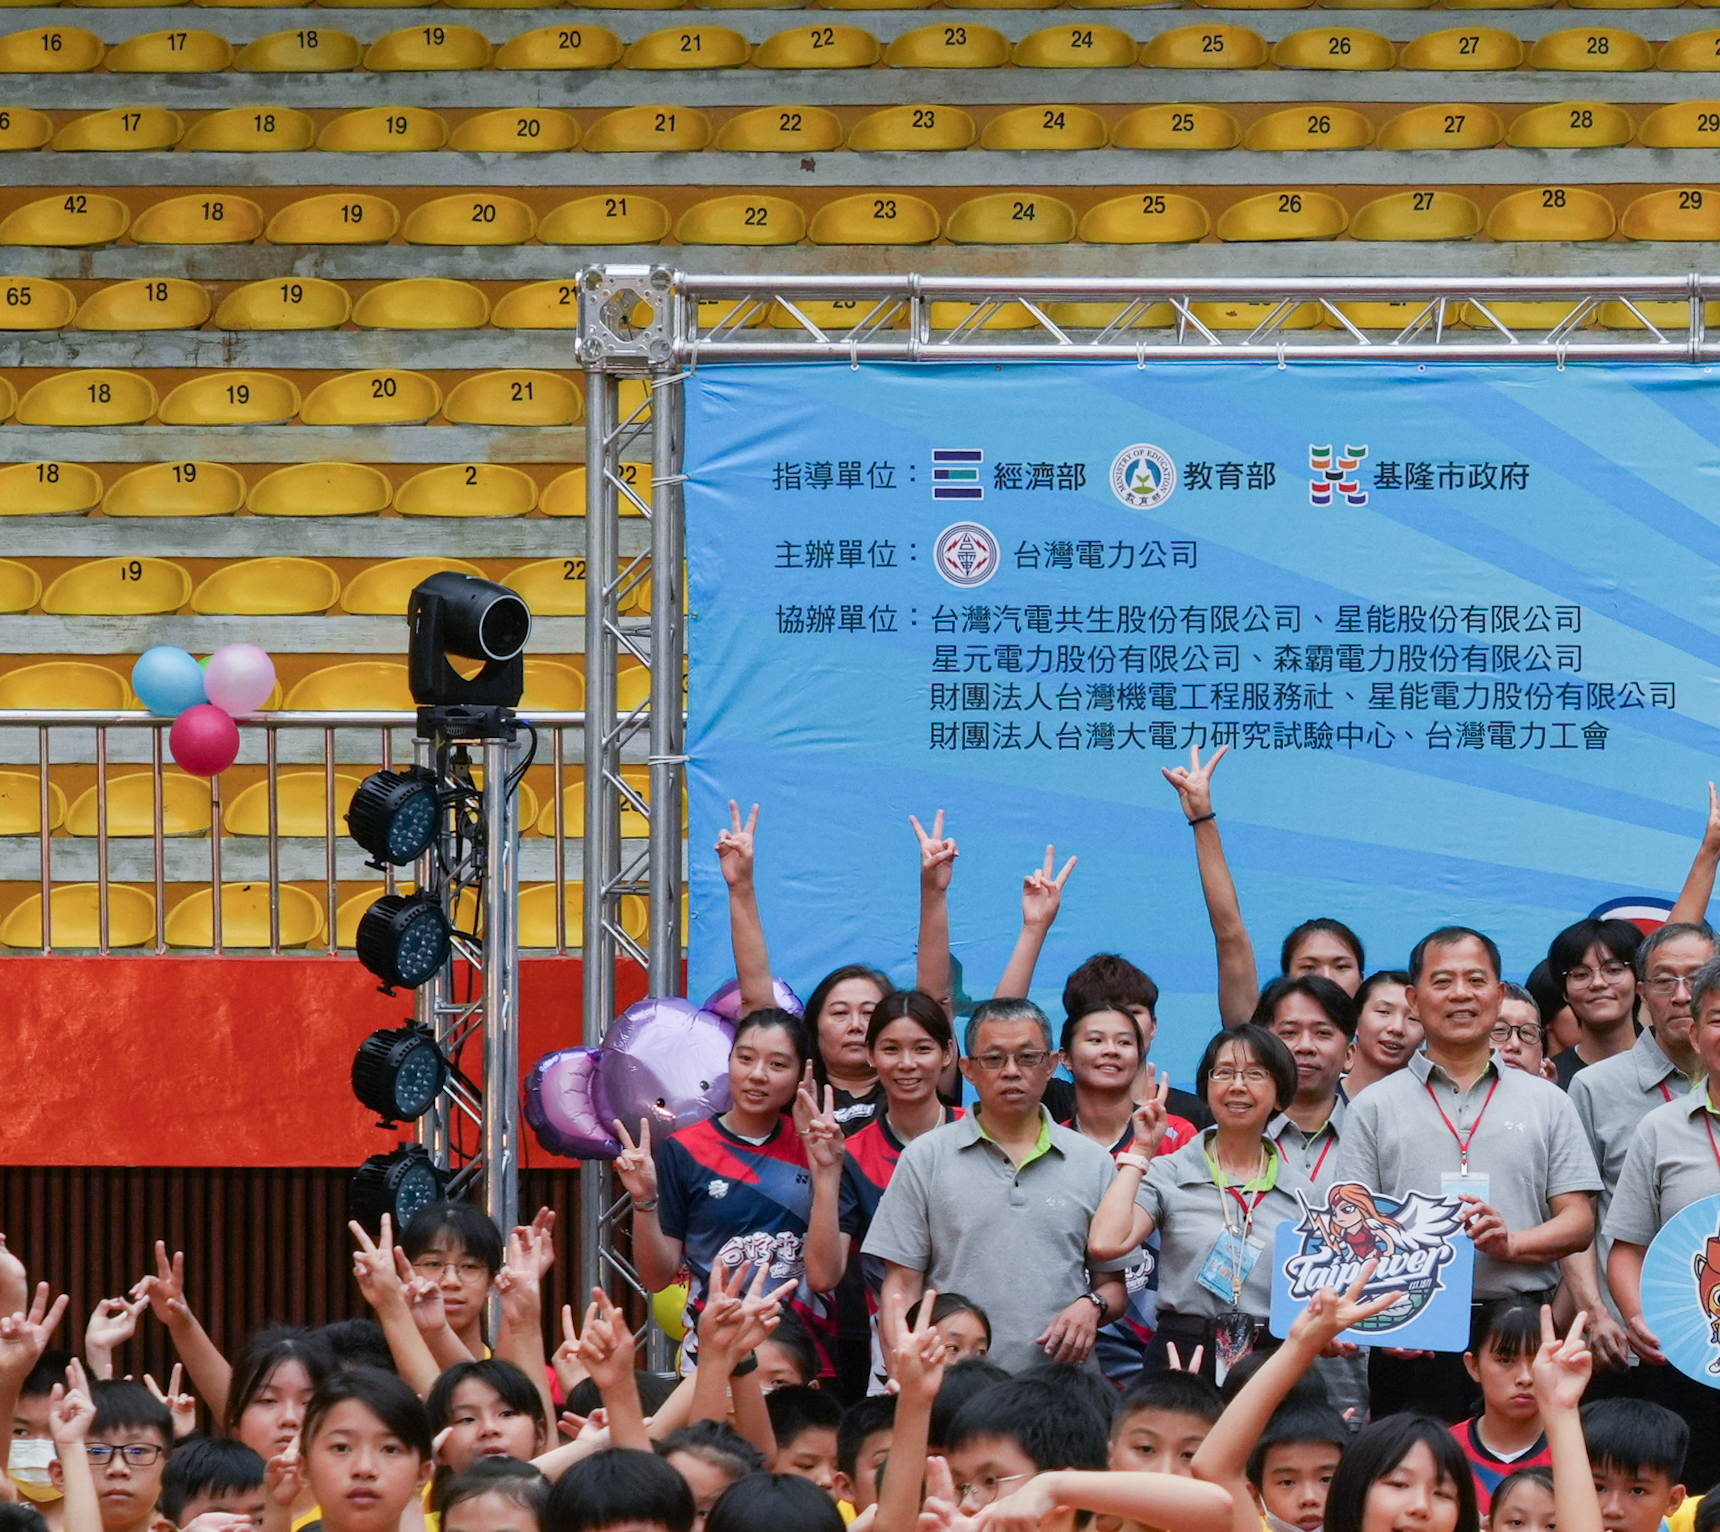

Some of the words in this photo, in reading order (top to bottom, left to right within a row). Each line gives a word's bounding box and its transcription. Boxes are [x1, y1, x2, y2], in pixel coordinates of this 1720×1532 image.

[40, 32, 63, 53] 16
[295, 29, 319, 50] 18
[557, 29, 582, 50] 20
[679, 33, 701, 53] 21
[943, 26, 967, 47] 23
[1458, 35, 1480, 56] 27
[120, 112, 142, 133] 17
[385, 115, 408, 136] 19
[654, 112, 676, 133] 21
[911, 108, 935, 130] 23
[1443, 114, 1466, 134] 27
[1696, 112, 1720, 133] 29
[63, 194, 88, 215] 42
[1277, 193, 1302, 214] 26
[1541, 188, 1566, 209] 28
[201, 201, 224, 223] 18
[470, 202, 496, 224] 20
[743, 206, 768, 227] 22
[5, 285, 32, 307] 65
[279, 283, 303, 305] 19
[87, 382, 111, 404] 18
[370, 376, 397, 399] 20
[35, 462, 59, 485] 18
[994, 461, 1087, 491] 經濟部
[1184, 461, 1277, 491] 教育部
[1373, 461, 1531, 491] 基隆市政府
[1014, 540, 1198, 569] 台灣電力公司
